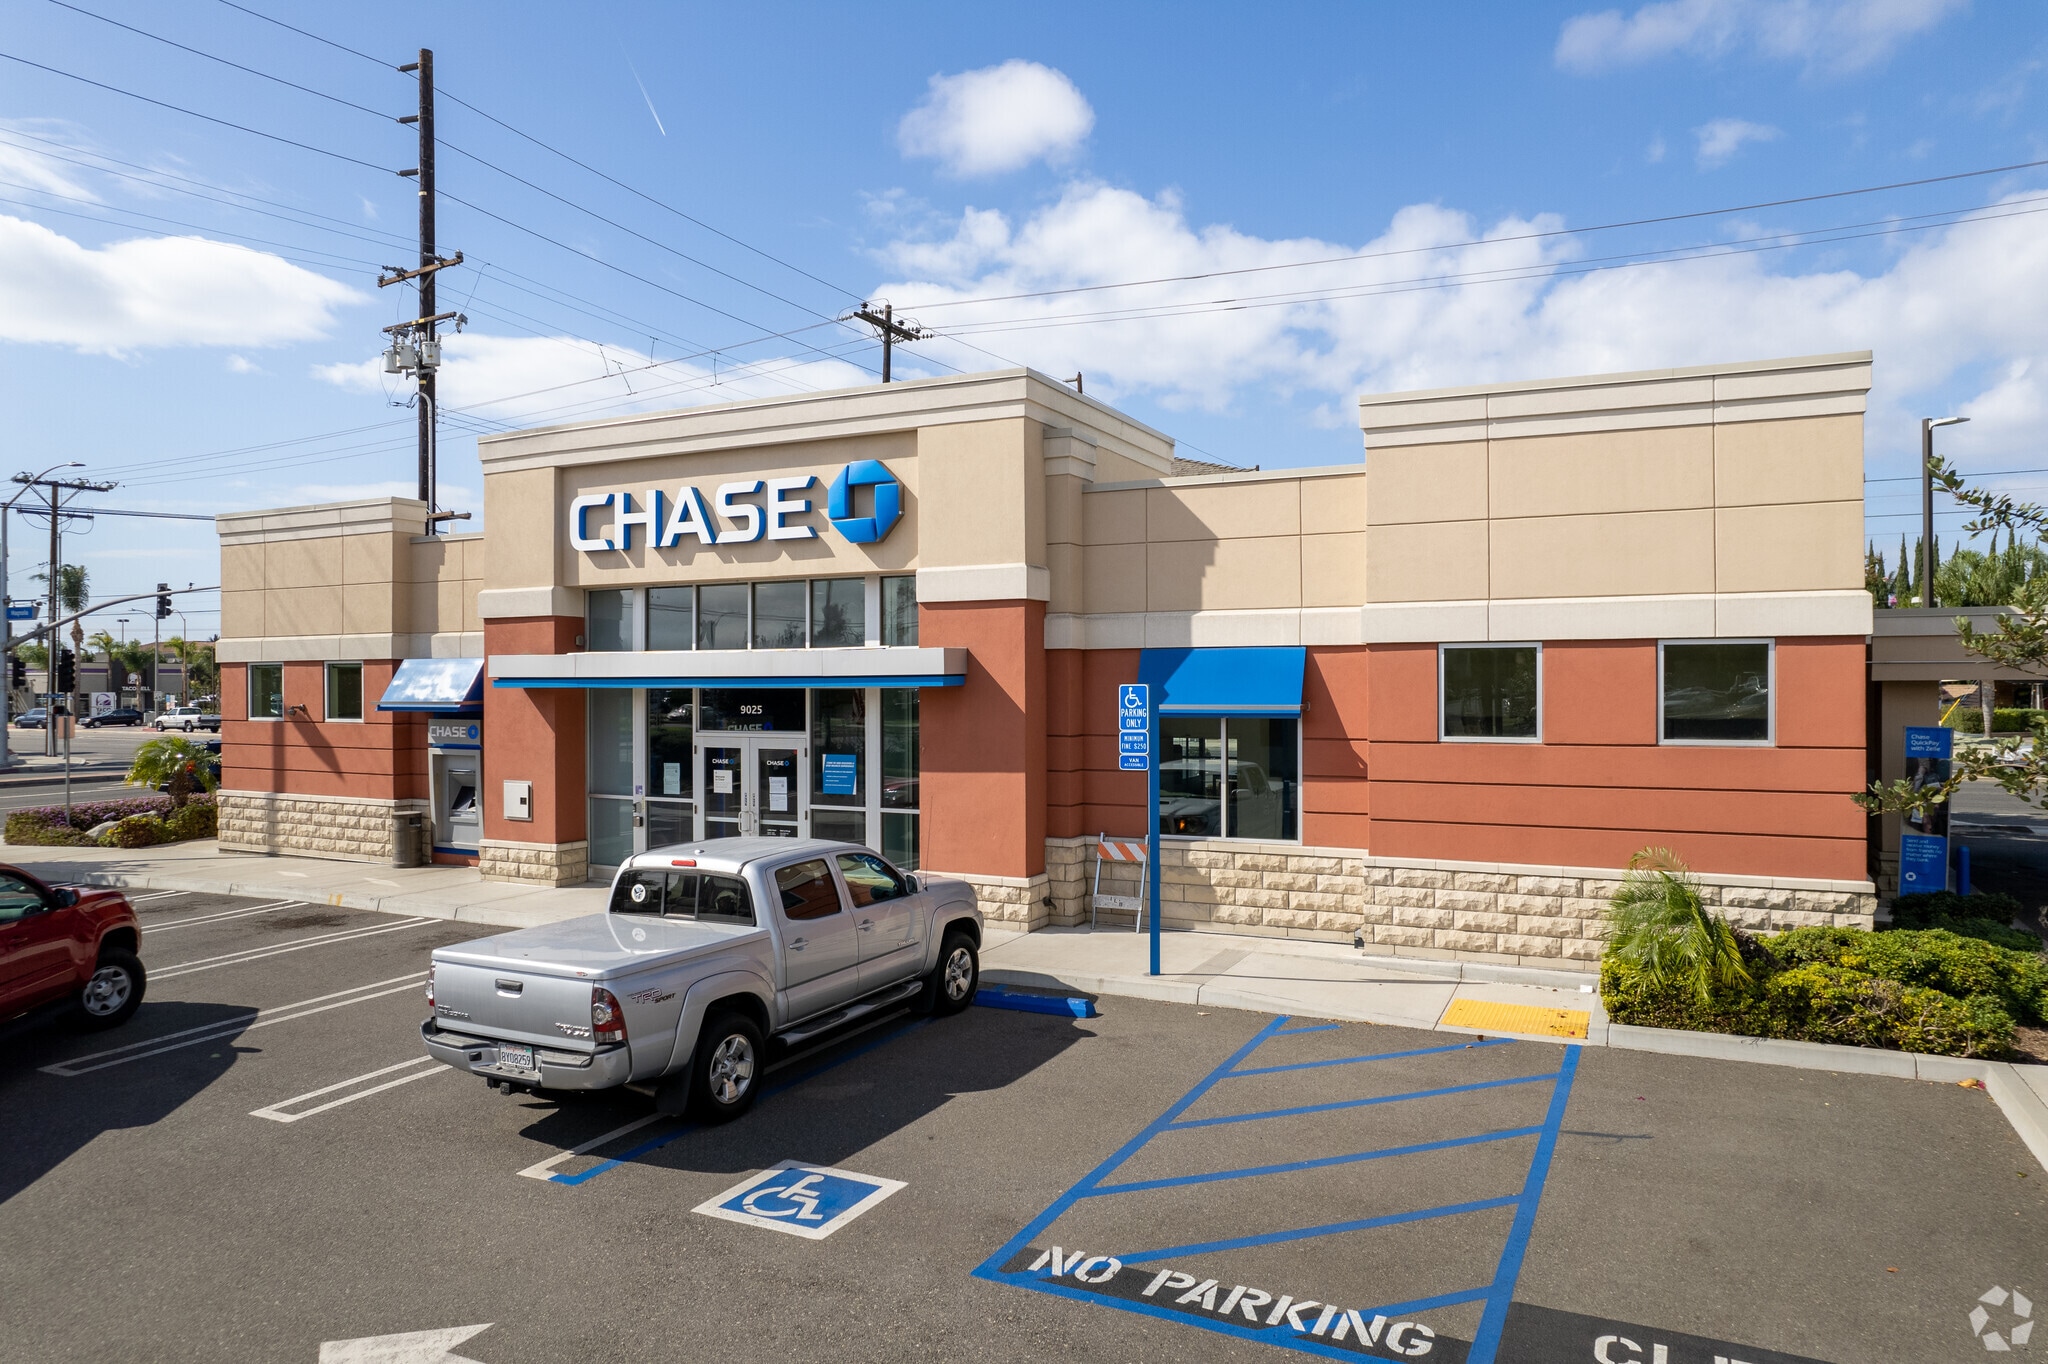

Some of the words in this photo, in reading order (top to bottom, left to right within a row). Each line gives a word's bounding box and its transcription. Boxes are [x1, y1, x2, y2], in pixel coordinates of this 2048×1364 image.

[569, 475, 818, 551] CHASE
[740, 705, 762, 714] 9025
[1121, 708, 1147, 717] PARKING
[1126, 718, 1142, 728] ONLY
[430, 726, 467, 738] CHASE
[1121, 742, 1132, 750] FINE
[1133, 742, 1147, 750] $250
[631, 988, 663, 1004] TRD
[654, 992, 676, 1004] SPORT
[501, 1051, 531, 1066] 8Y08259
[1027, 1246, 1121, 1283] NO
[1141, 1269, 1435, 1355] PARKING
